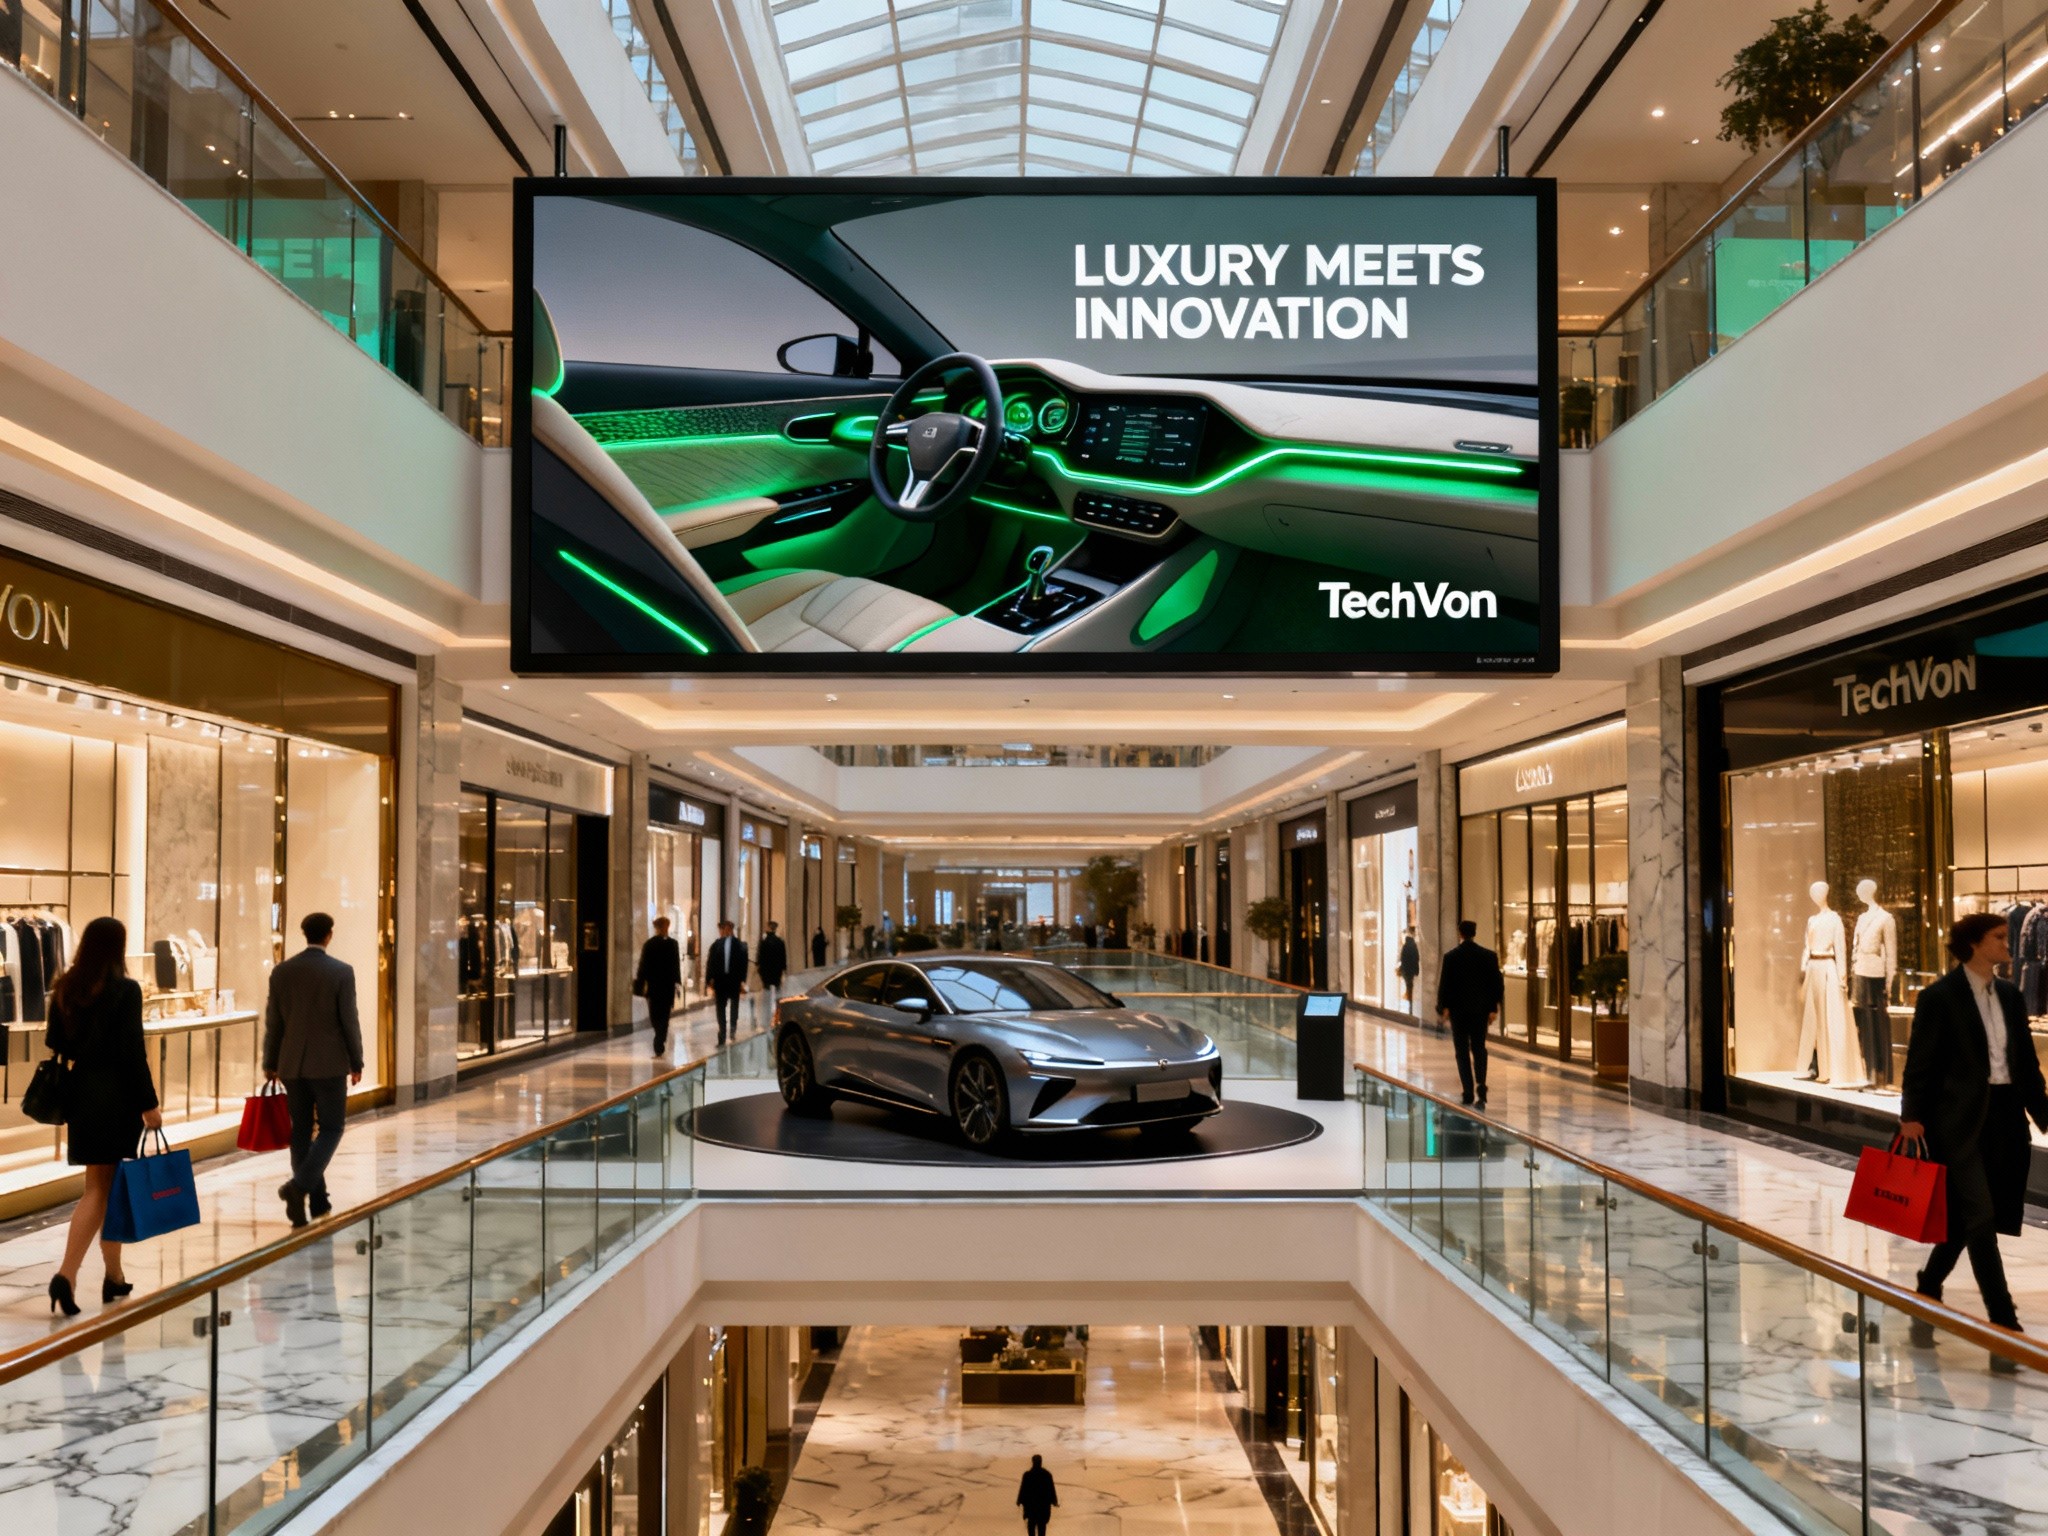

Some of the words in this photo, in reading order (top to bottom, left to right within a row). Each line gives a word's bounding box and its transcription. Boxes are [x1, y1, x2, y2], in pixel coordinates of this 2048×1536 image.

[1075, 244, 1290, 286] LUXURY
[1306, 244, 1485, 286] MEETS
[1075, 296, 1409, 340] INNOVATION
[1318, 581, 1498, 619] TechVon
